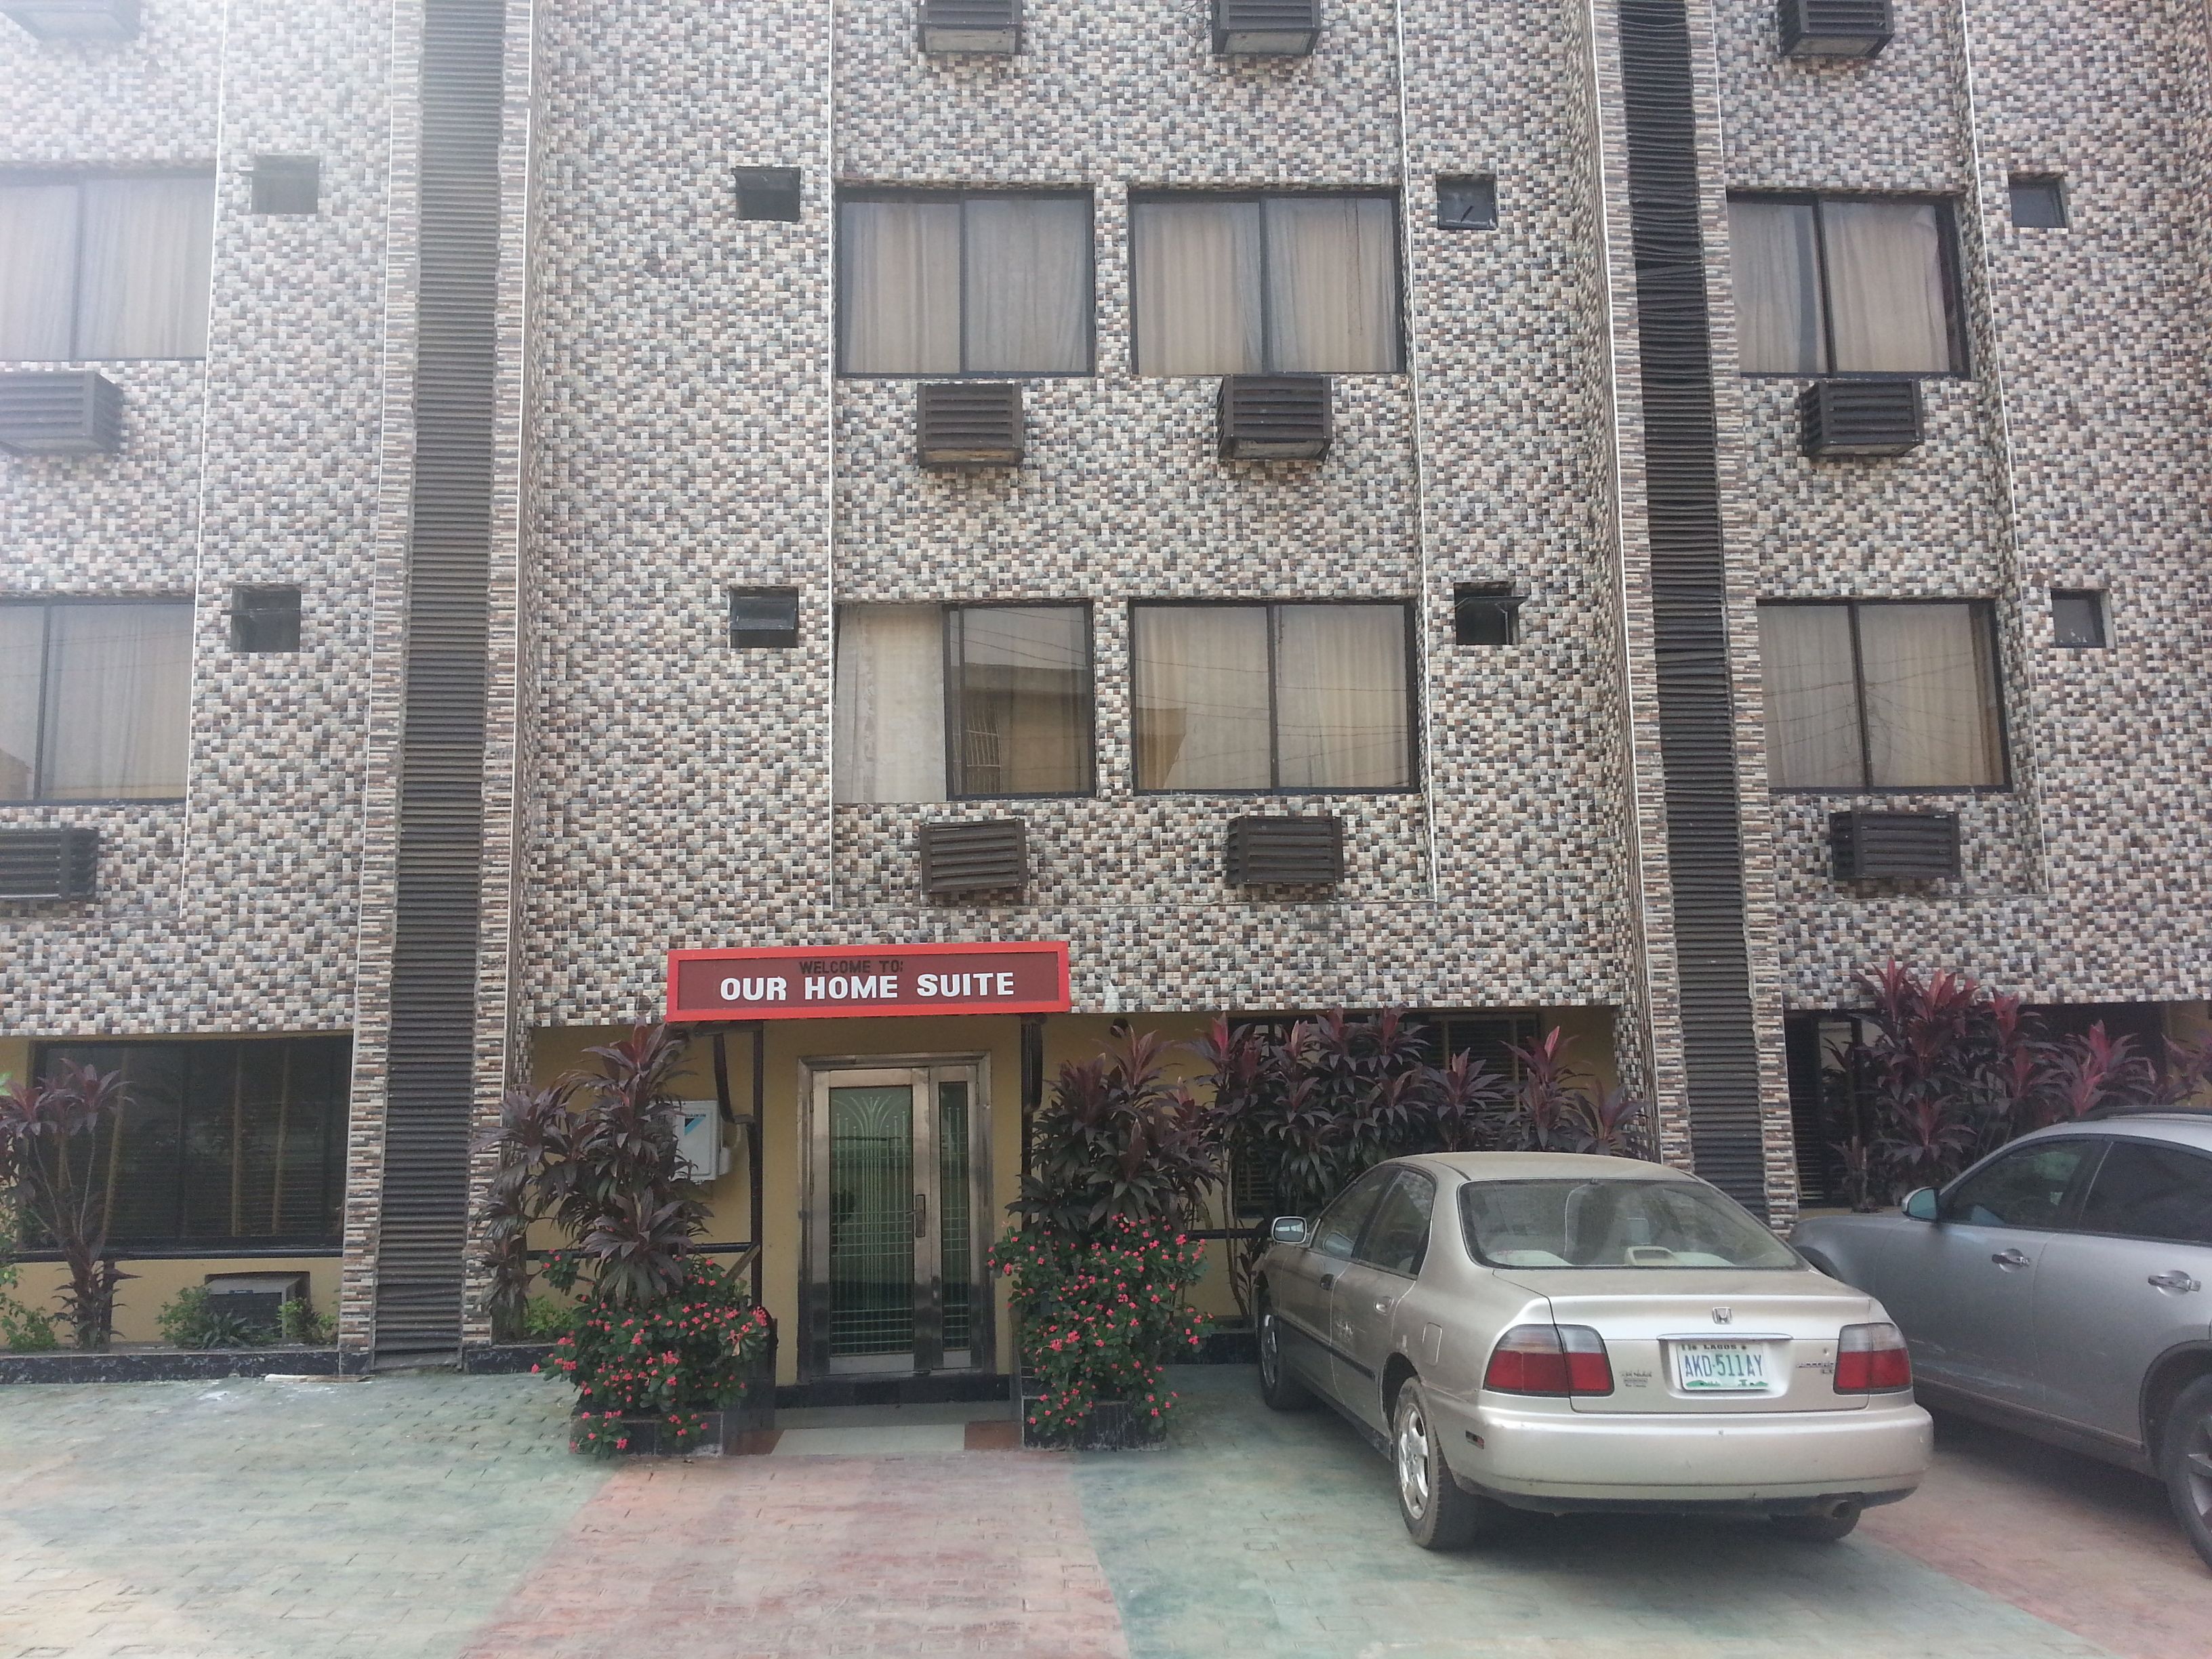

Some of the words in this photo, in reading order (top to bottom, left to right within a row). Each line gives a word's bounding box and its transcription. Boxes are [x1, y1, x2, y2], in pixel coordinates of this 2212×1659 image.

[800, 960, 871, 975] WELCOME
[720, 977, 787, 1000] OUR
[804, 975, 898, 1000] HOME
[917, 972, 1015, 997] SUITE
